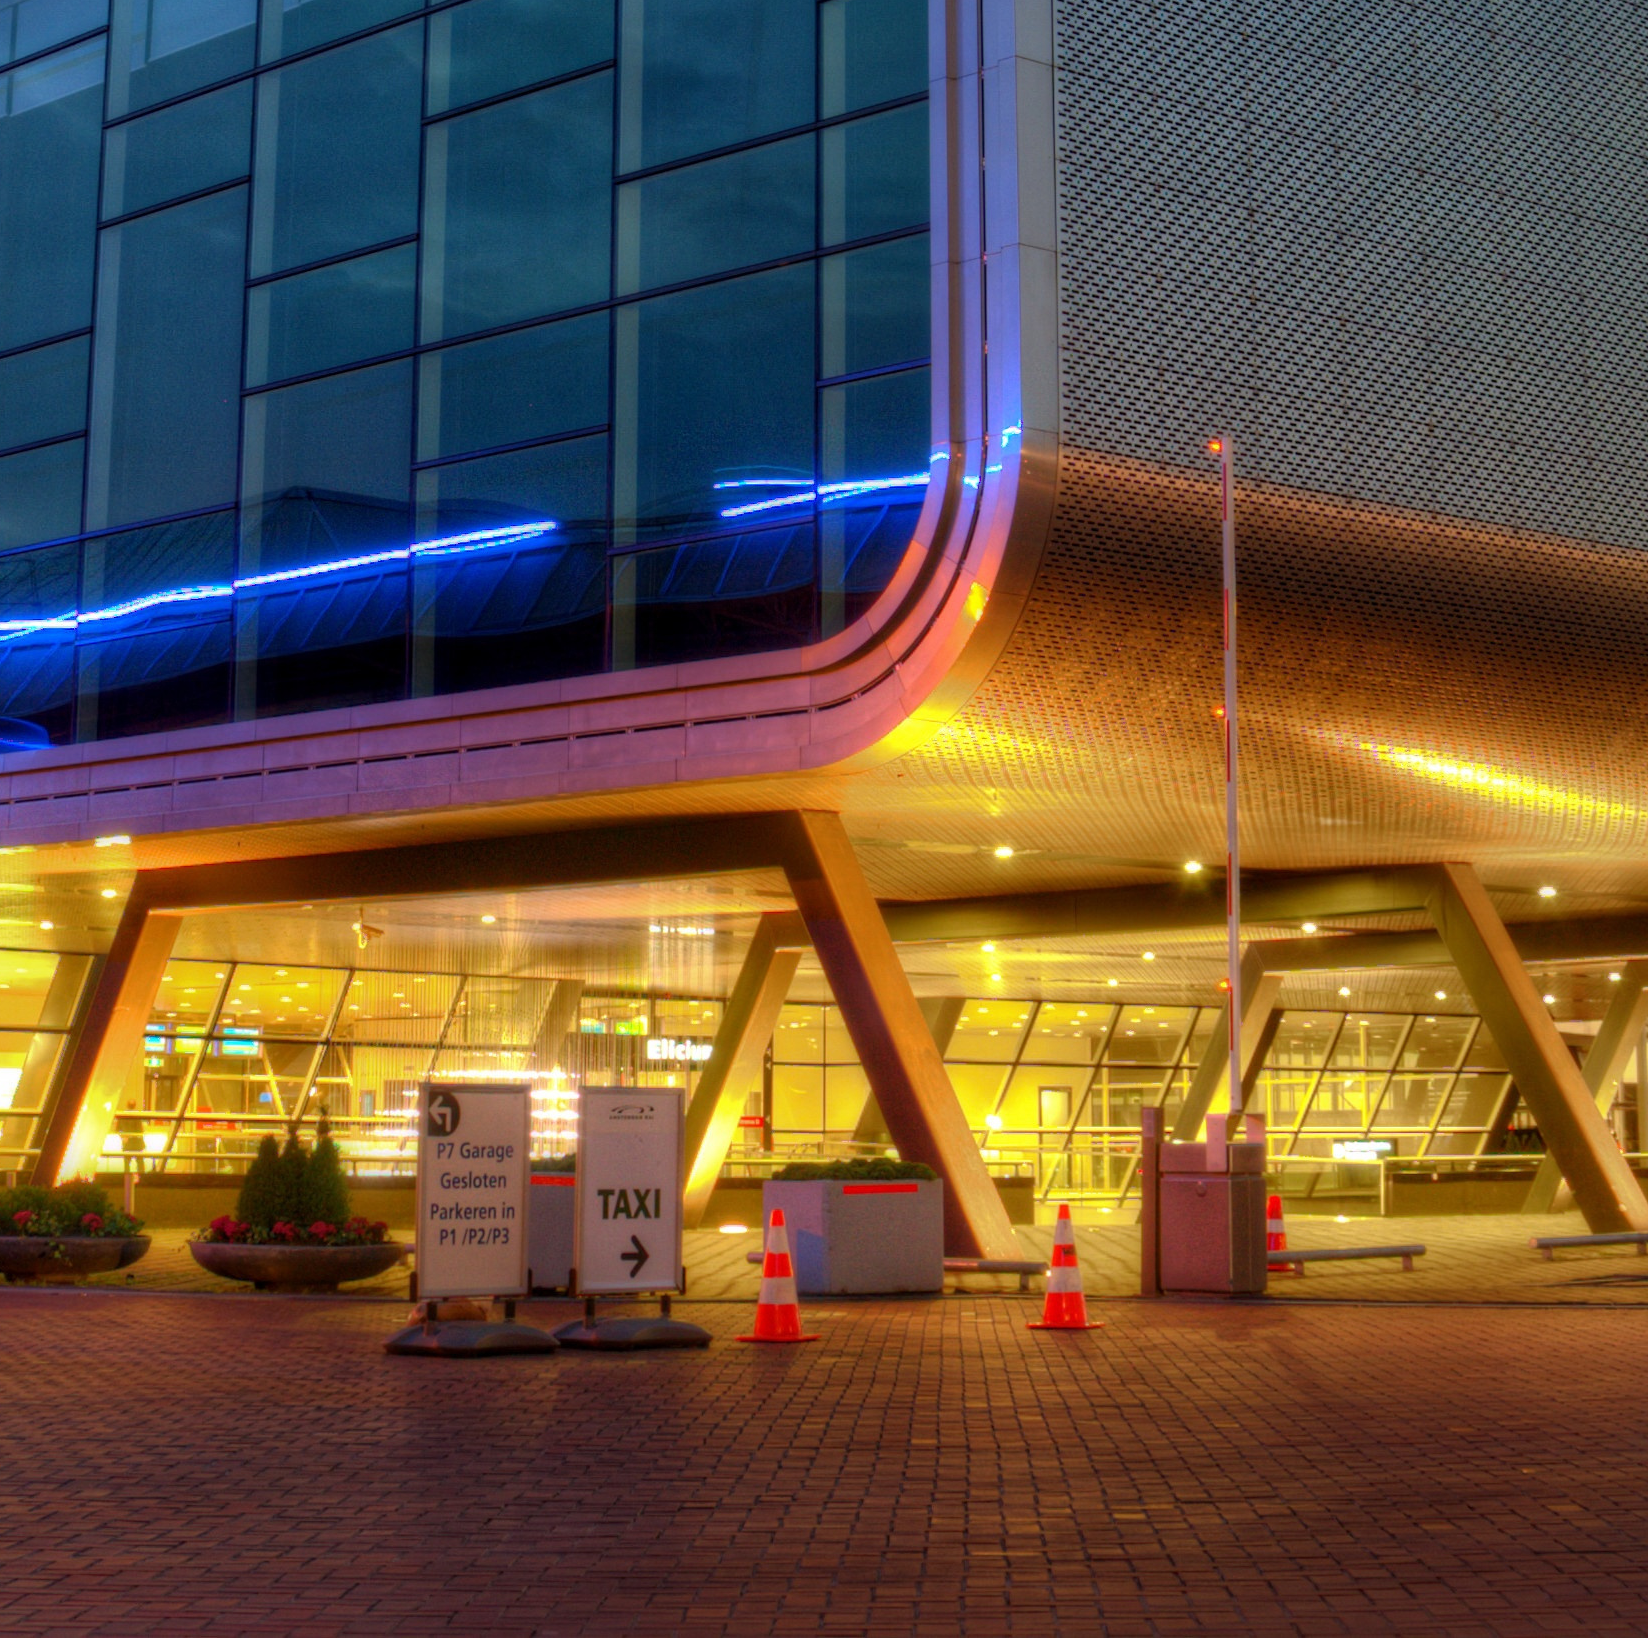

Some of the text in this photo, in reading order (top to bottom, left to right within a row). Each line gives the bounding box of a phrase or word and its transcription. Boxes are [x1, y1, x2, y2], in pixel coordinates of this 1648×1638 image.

[437, 1142, 514, 1163] P7 Garage
[440, 1171, 507, 1189] Gesloten
[430, 1202, 515, 1220] Parkeren in
[597, 1188, 661, 1220] TAXI
[440, 1229, 455, 1246] P1
